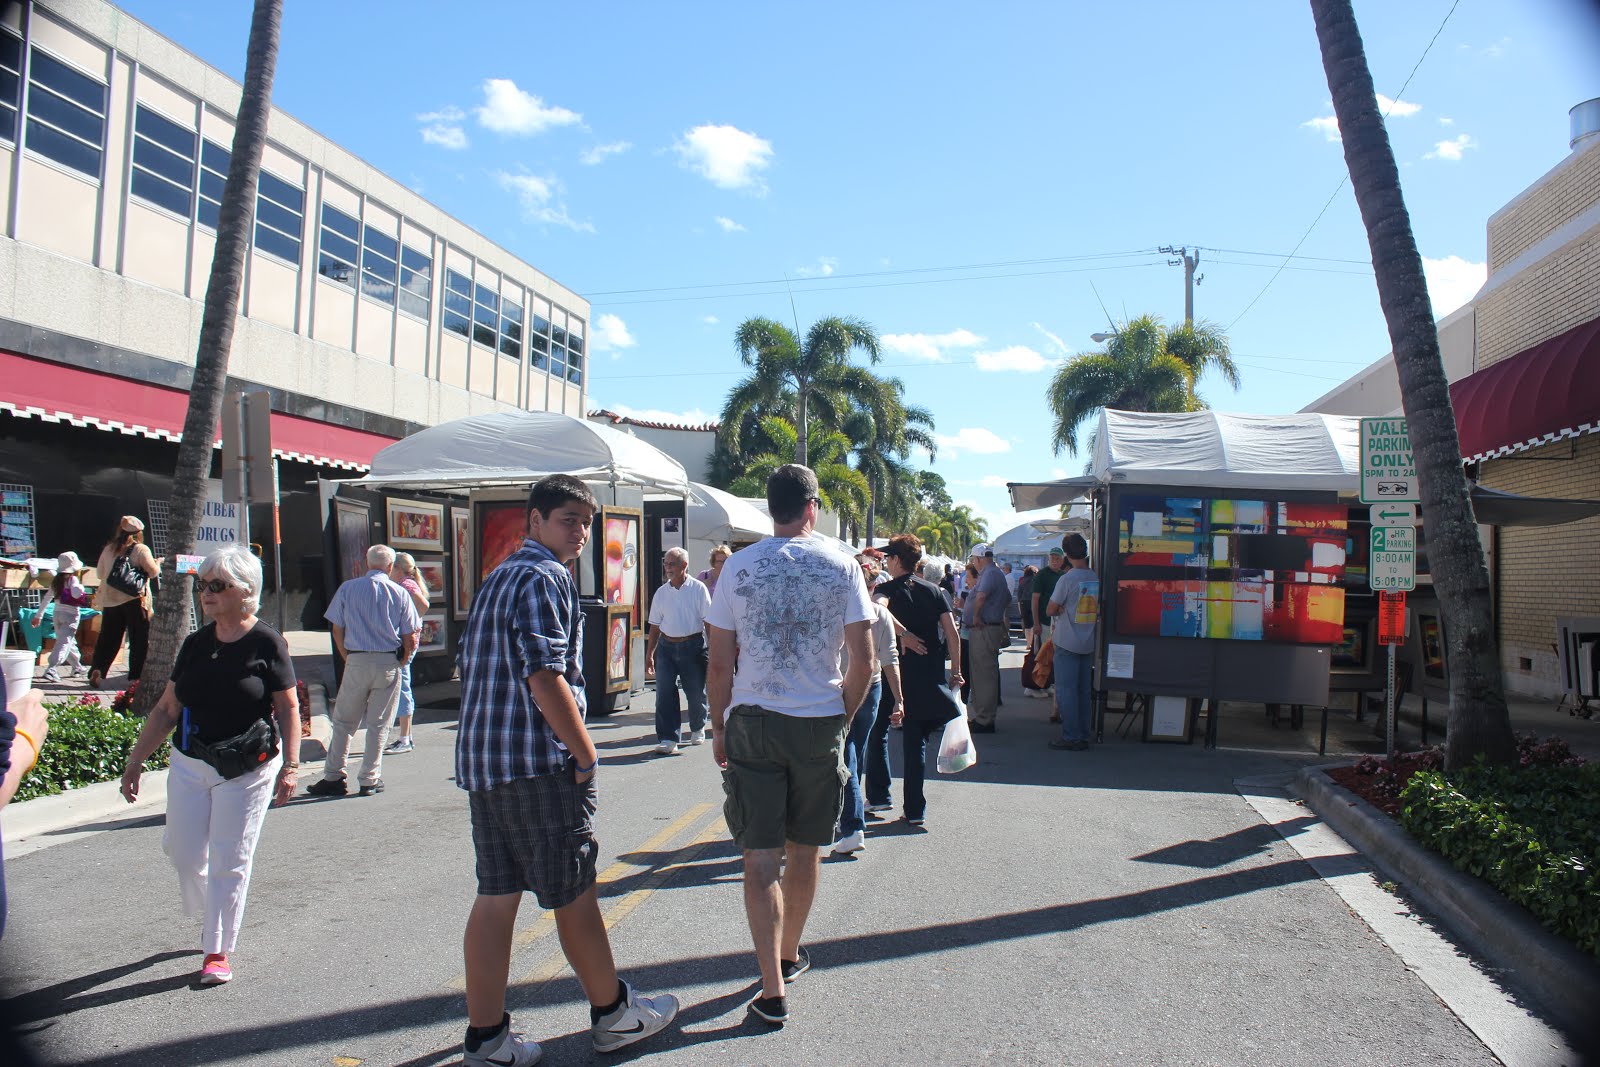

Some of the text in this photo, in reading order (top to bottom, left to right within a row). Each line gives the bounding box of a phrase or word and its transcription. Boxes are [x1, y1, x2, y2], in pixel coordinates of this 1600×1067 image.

[1369, 421, 1408, 435] VALE
[1369, 438, 1412, 452] PARKIN
[1371, 454, 1415, 467] ONLY
[1365, 469, 1417, 477] 5PM TO 2A
[196, 526, 235, 542] DRUGS
[1374, 530, 1405, 547] 2 HR
[1386, 540, 1412, 548] PARKING
